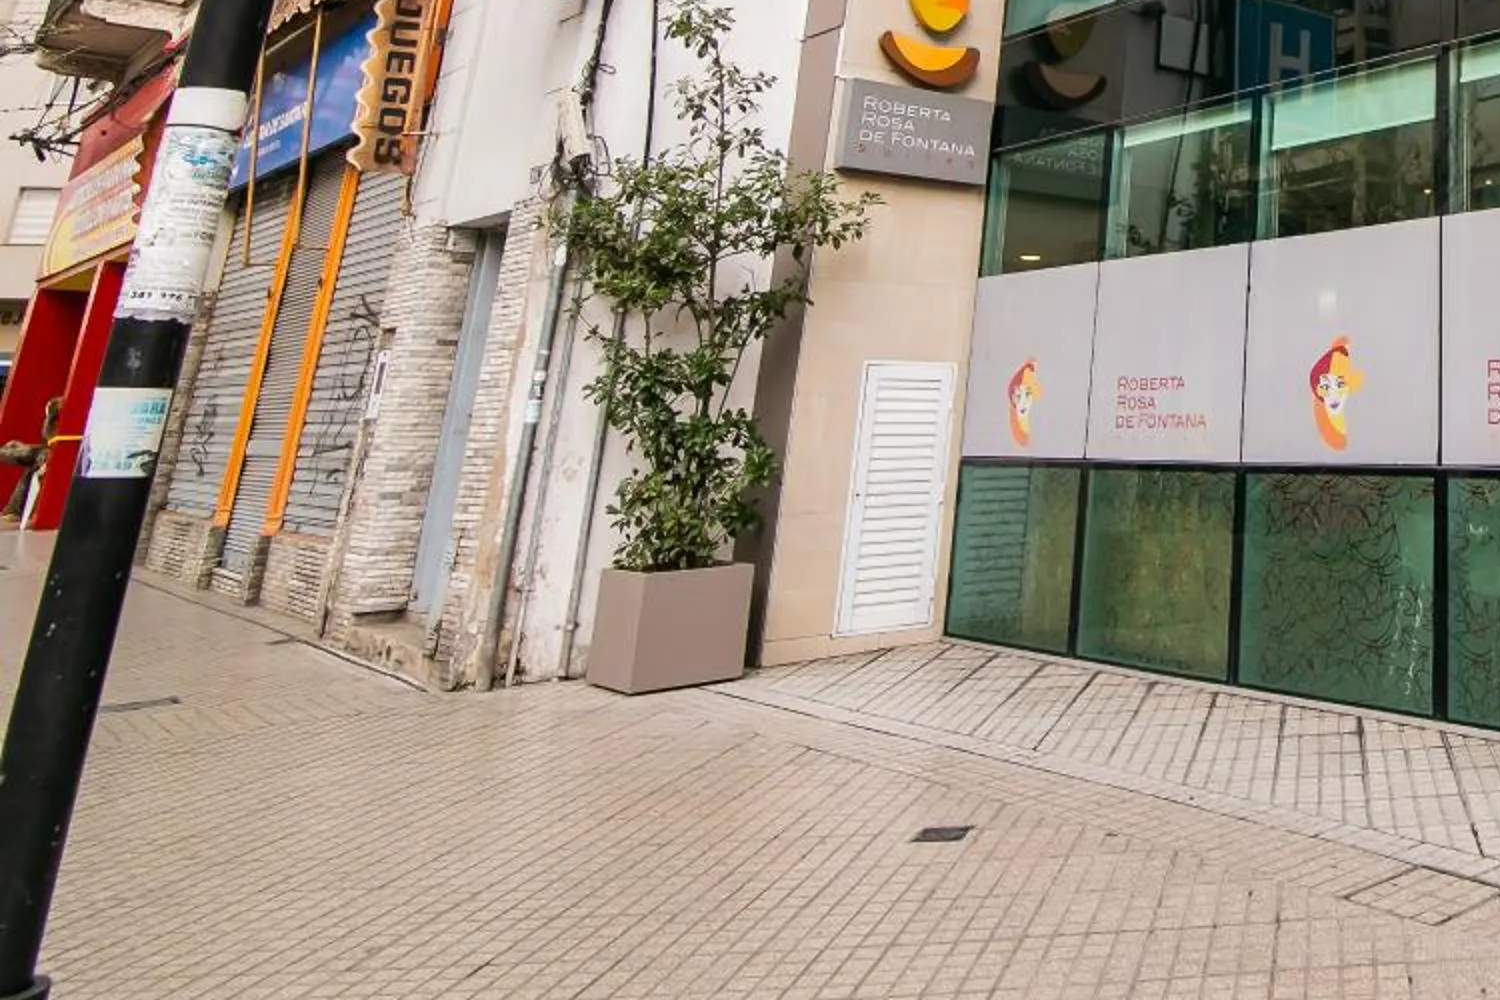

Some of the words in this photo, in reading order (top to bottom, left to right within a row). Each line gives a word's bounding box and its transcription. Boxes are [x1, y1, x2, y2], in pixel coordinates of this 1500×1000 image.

[862, 95, 951, 121] ROBERTA
[861, 112, 915, 132] ROSA
[860, 130, 885, 143] DE
[891, 132, 976, 157] FONTANA
[1117, 375, 1185, 391] ROBERTA
[1117, 395, 1156, 410] ROSA
[1115, 415, 1134, 429] DE
[1138, 412, 1206, 429] FONTANA
